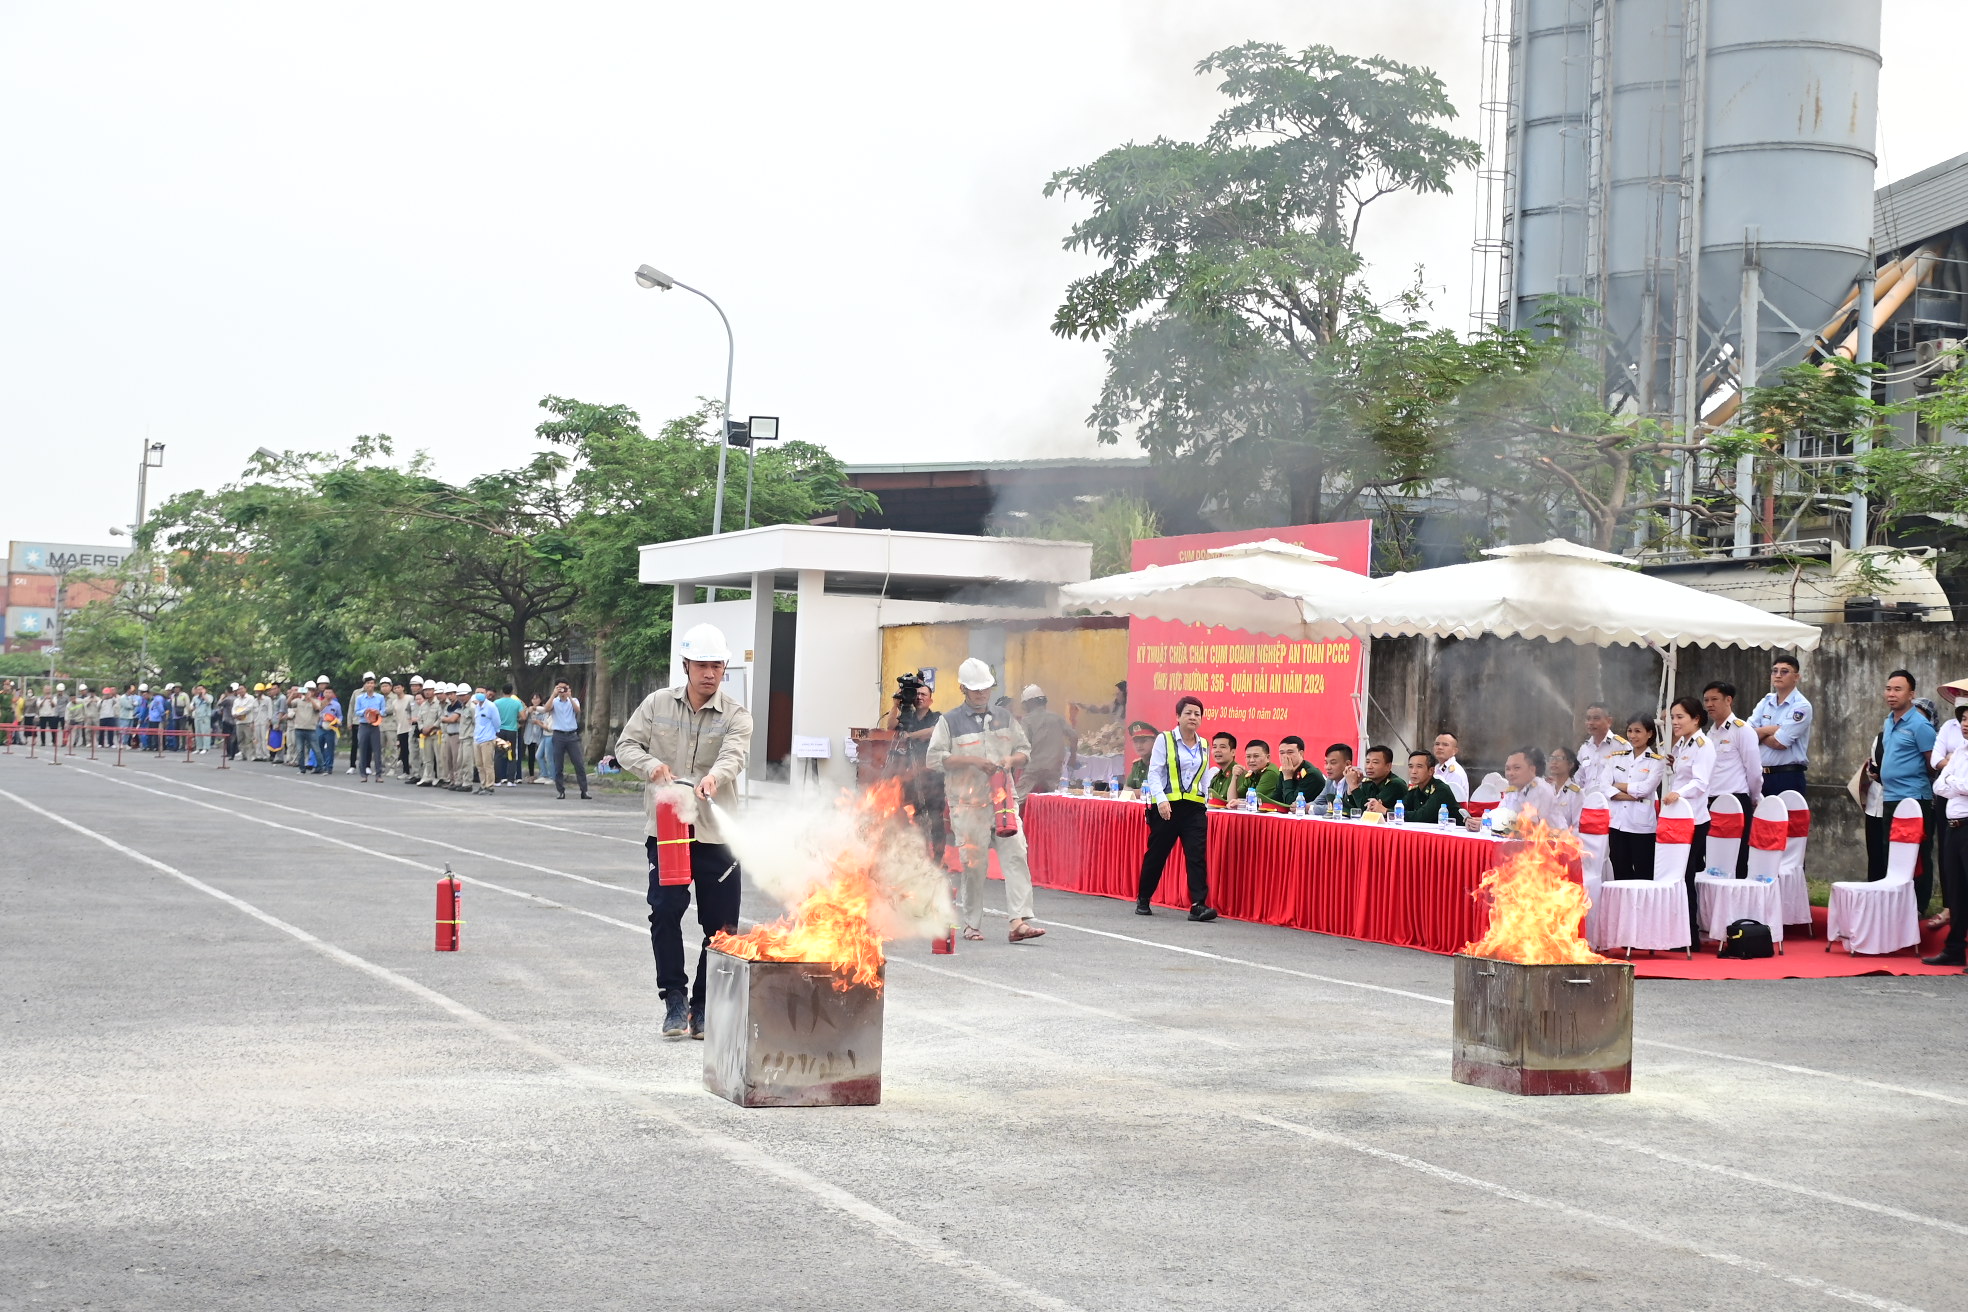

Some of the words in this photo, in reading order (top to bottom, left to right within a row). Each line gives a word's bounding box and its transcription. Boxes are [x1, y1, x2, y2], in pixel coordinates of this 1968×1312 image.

[49, 552, 124, 567] MAERS
[1147, 641, 1168, 667] THUẬT
[1169, 641, 1188, 664] CHỮA
[1210, 644, 1228, 668] CỤM
[1229, 644, 1255, 664] DOANH
[1256, 640, 1287, 668] NGHIỆP
[1288, 643, 1301, 664] AN
[1326, 642, 1350, 664] PCCC
[1210, 673, 1225, 692] 356
[1231, 669, 1252, 697] QUẬN
[1253, 666, 1268, 693] HẢI
[1269, 673, 1282, 693] AN
[1282, 669, 1303, 694] NĂM
[1303, 673, 1325, 694] 2024
[1219, 706, 1228, 719] 30
[1228, 706, 1247, 722] tháng
[1248, 707, 1256, 720] 10
[1256, 708, 1272, 720] năm
[1272, 707, 1289, 721] 2024
